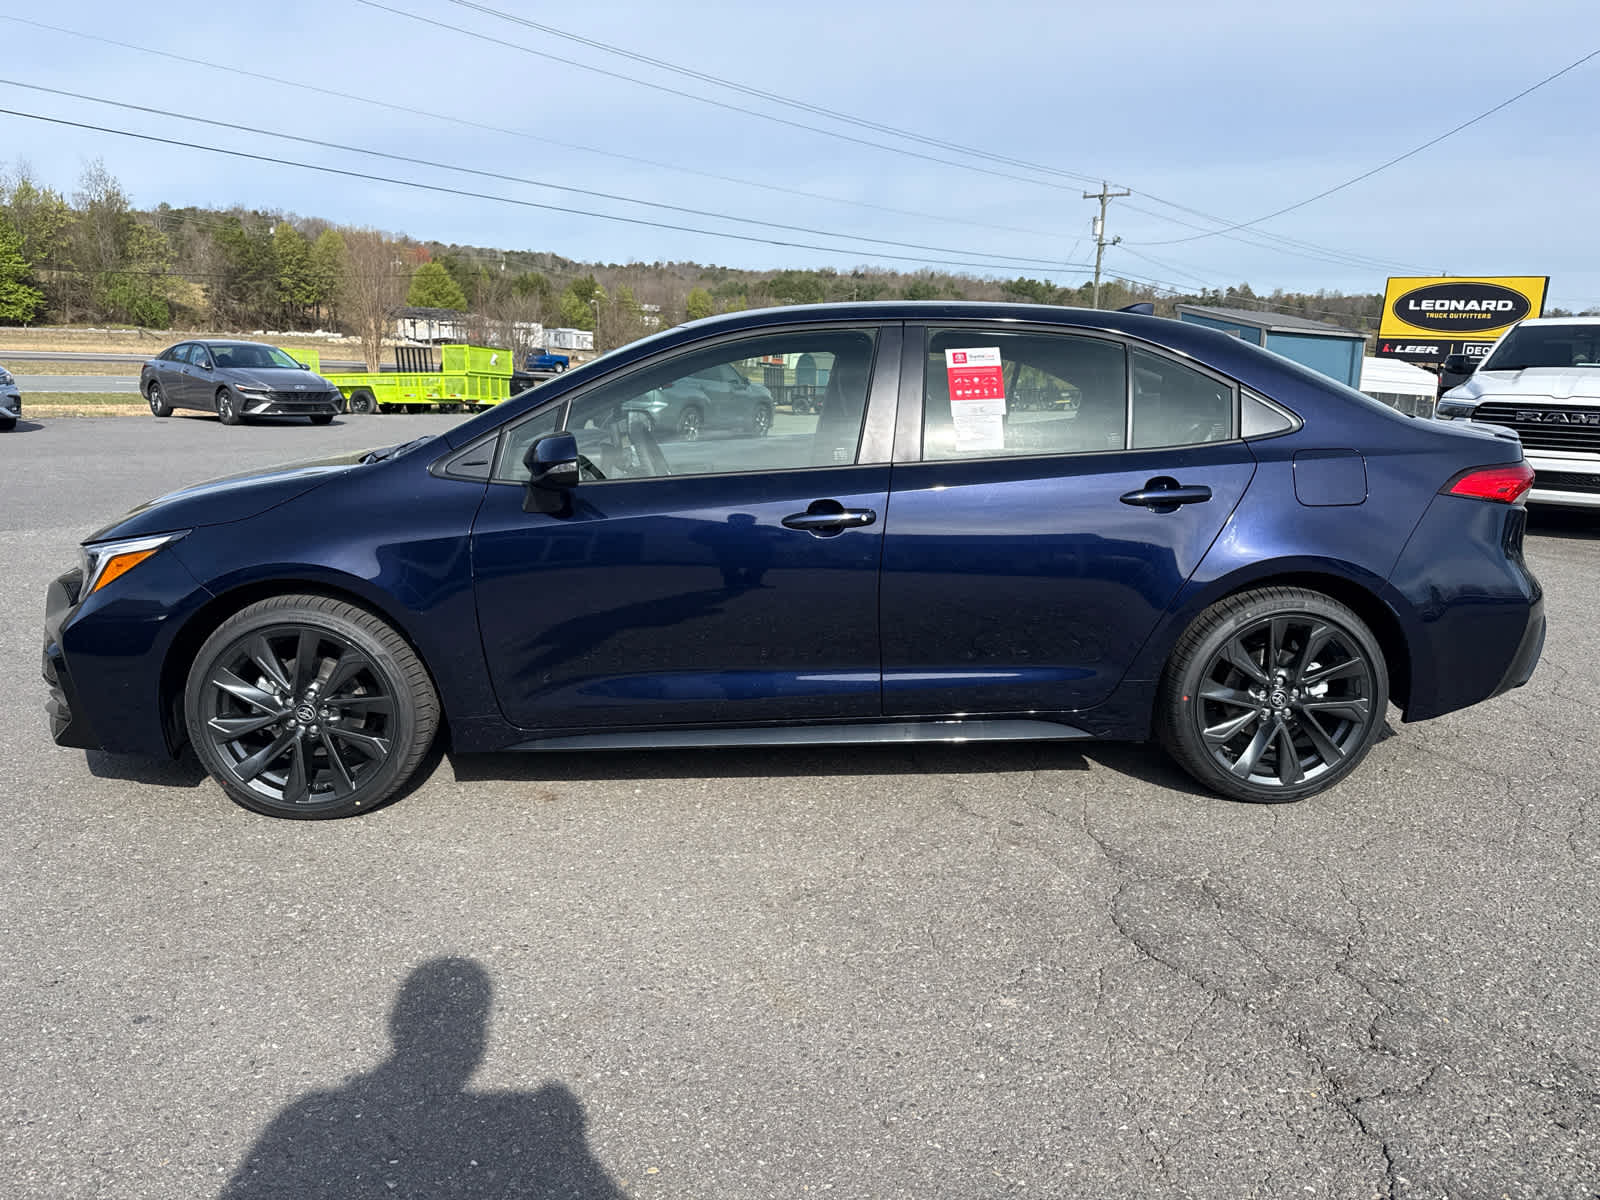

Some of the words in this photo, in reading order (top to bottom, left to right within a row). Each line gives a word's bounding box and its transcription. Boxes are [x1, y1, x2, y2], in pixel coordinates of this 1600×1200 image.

[1408, 299, 1514, 311] LEONARD
[1449, 312, 1492, 320] OUTFITTERS
[1394, 345, 1440, 355] LEER
[1466, 346, 1490, 355] DEC
[1516, 411, 1600, 425] RAM
